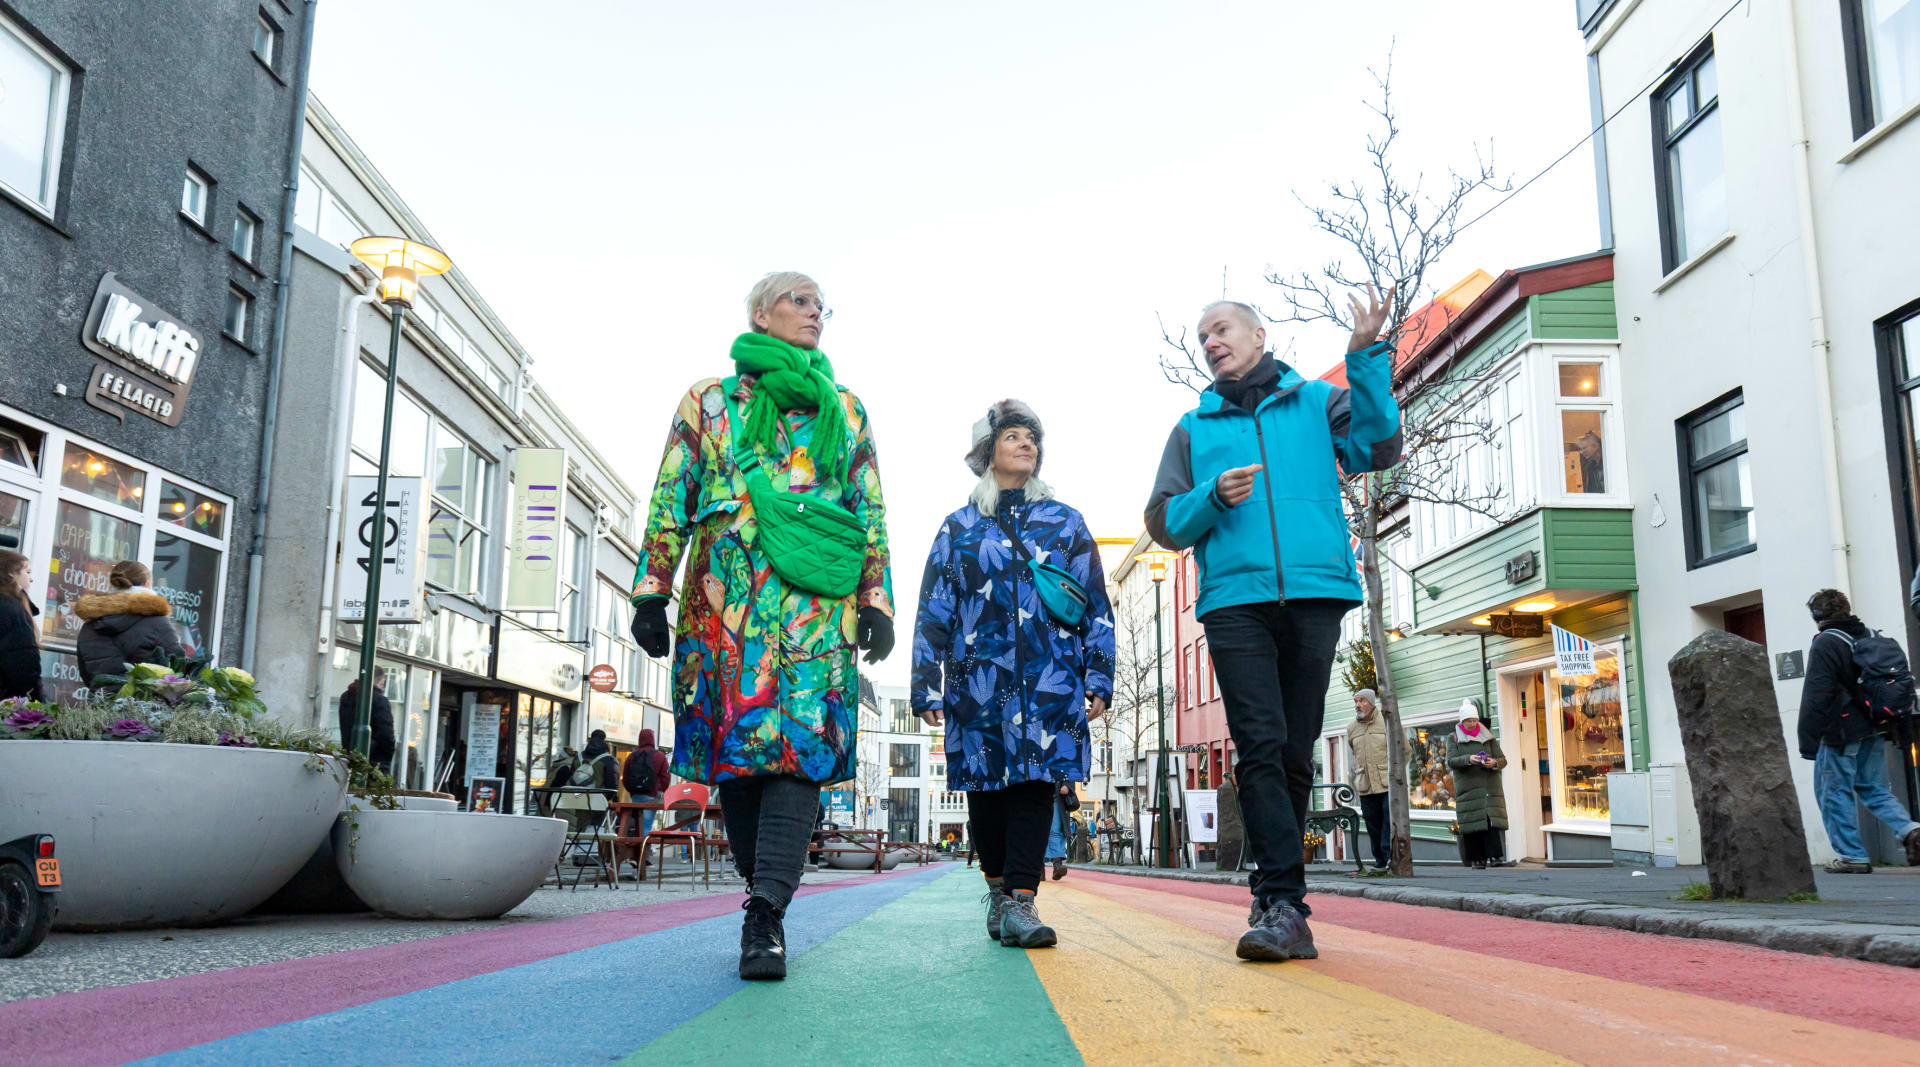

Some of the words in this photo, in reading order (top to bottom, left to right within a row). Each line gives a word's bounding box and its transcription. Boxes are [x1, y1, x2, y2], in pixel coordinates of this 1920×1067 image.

[97, 293, 199, 385] Kaffi
[100, 372, 174, 417] FÉLAGIÐ
[524, 485, 557, 571] BINGO
[1560, 654, 1573, 663] TAX
[1574, 653, 1590, 662] FREE
[1561, 662, 1592, 671] SHOPPING
[39, 862, 57, 871] CU
[41, 873, 57, 883] T3
